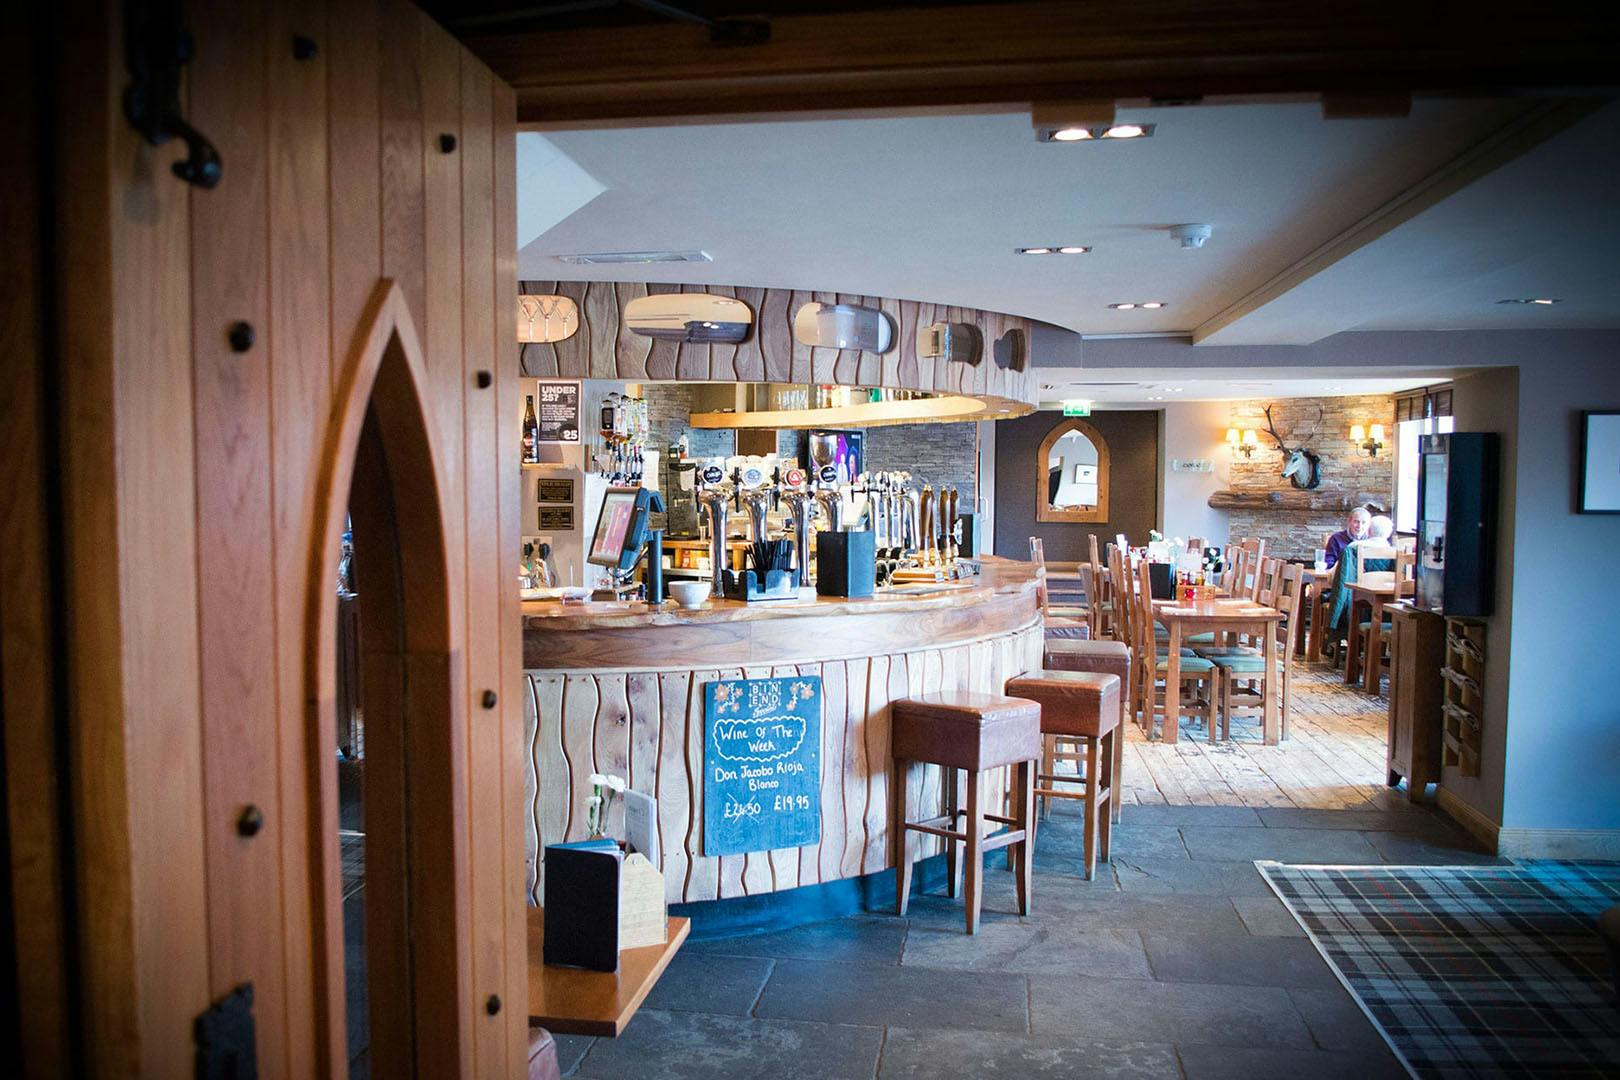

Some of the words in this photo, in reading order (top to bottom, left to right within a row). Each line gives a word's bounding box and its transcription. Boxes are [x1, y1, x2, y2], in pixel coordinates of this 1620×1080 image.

[541, 386, 576, 394] UNDER
[541, 394, 559, 402] 25?
[563, 430, 578, 440] 25
[752, 684, 779, 694] BIN
[752, 695, 779, 705] END
[719, 725, 749, 740] Wine
[755, 727, 767, 739] Of
[771, 724, 793, 738] The
[748, 740, 776, 753] Week
[715, 767, 738, 782] Don
[740, 765, 774, 778] Jacobo
[776, 761, 804, 776] Rioja
[749, 779, 780, 791] Blanco
